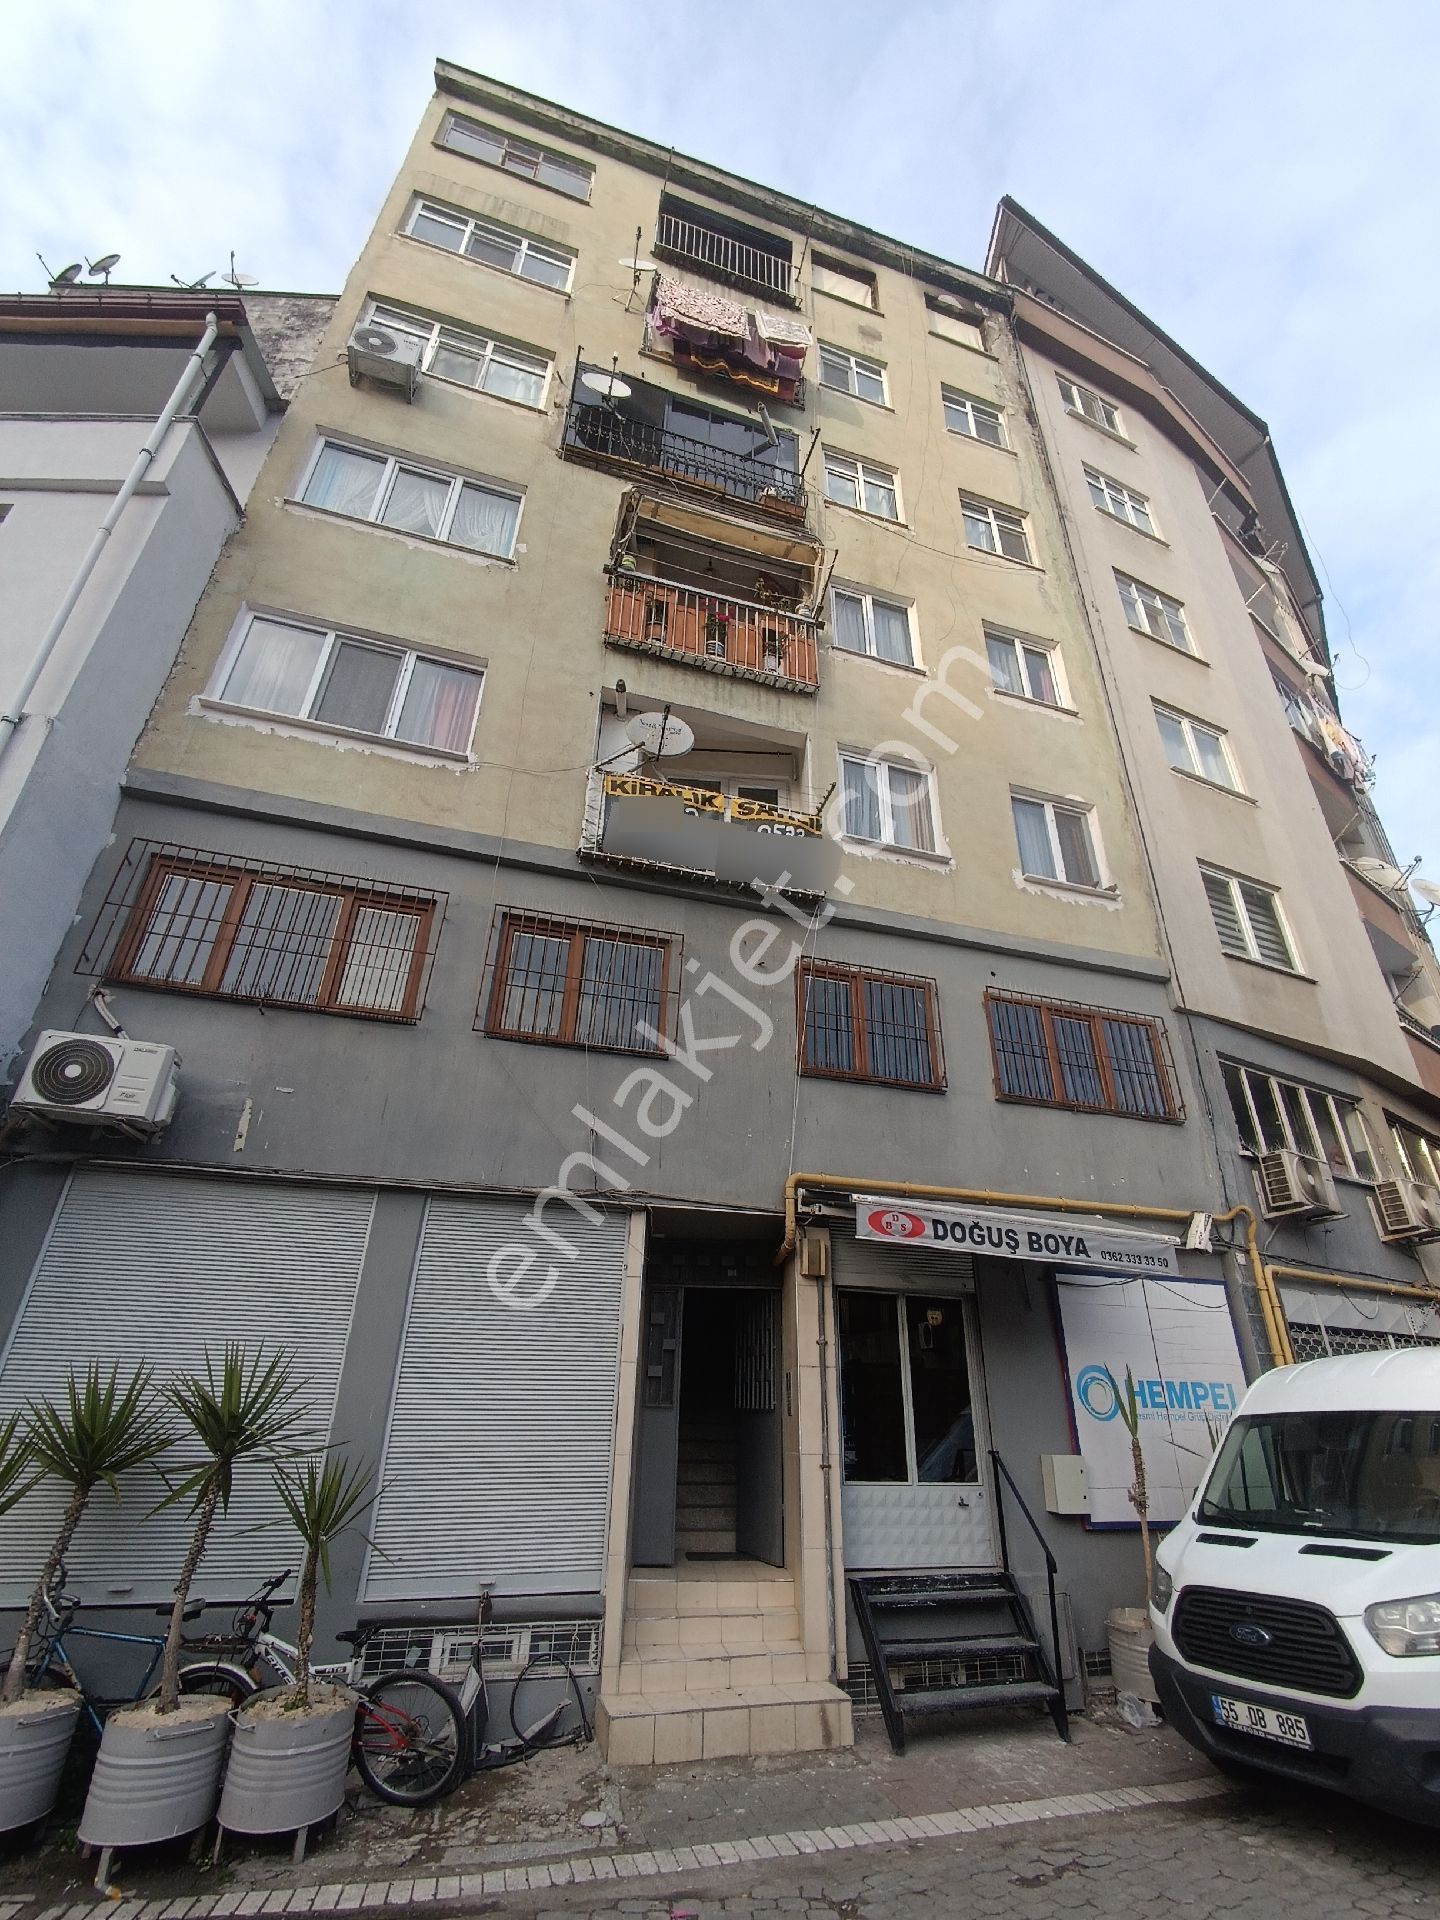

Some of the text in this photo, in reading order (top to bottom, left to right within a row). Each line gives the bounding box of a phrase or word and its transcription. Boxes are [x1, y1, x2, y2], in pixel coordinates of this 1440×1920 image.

[932, 1219, 1169, 1268] DOĞUŞ BOYA 0362 333 33 50
[1220, 1699, 1239, 1721] 55
[1247, 1705, 1267, 1729] DB
[1276, 1713, 1306, 1740] 885
